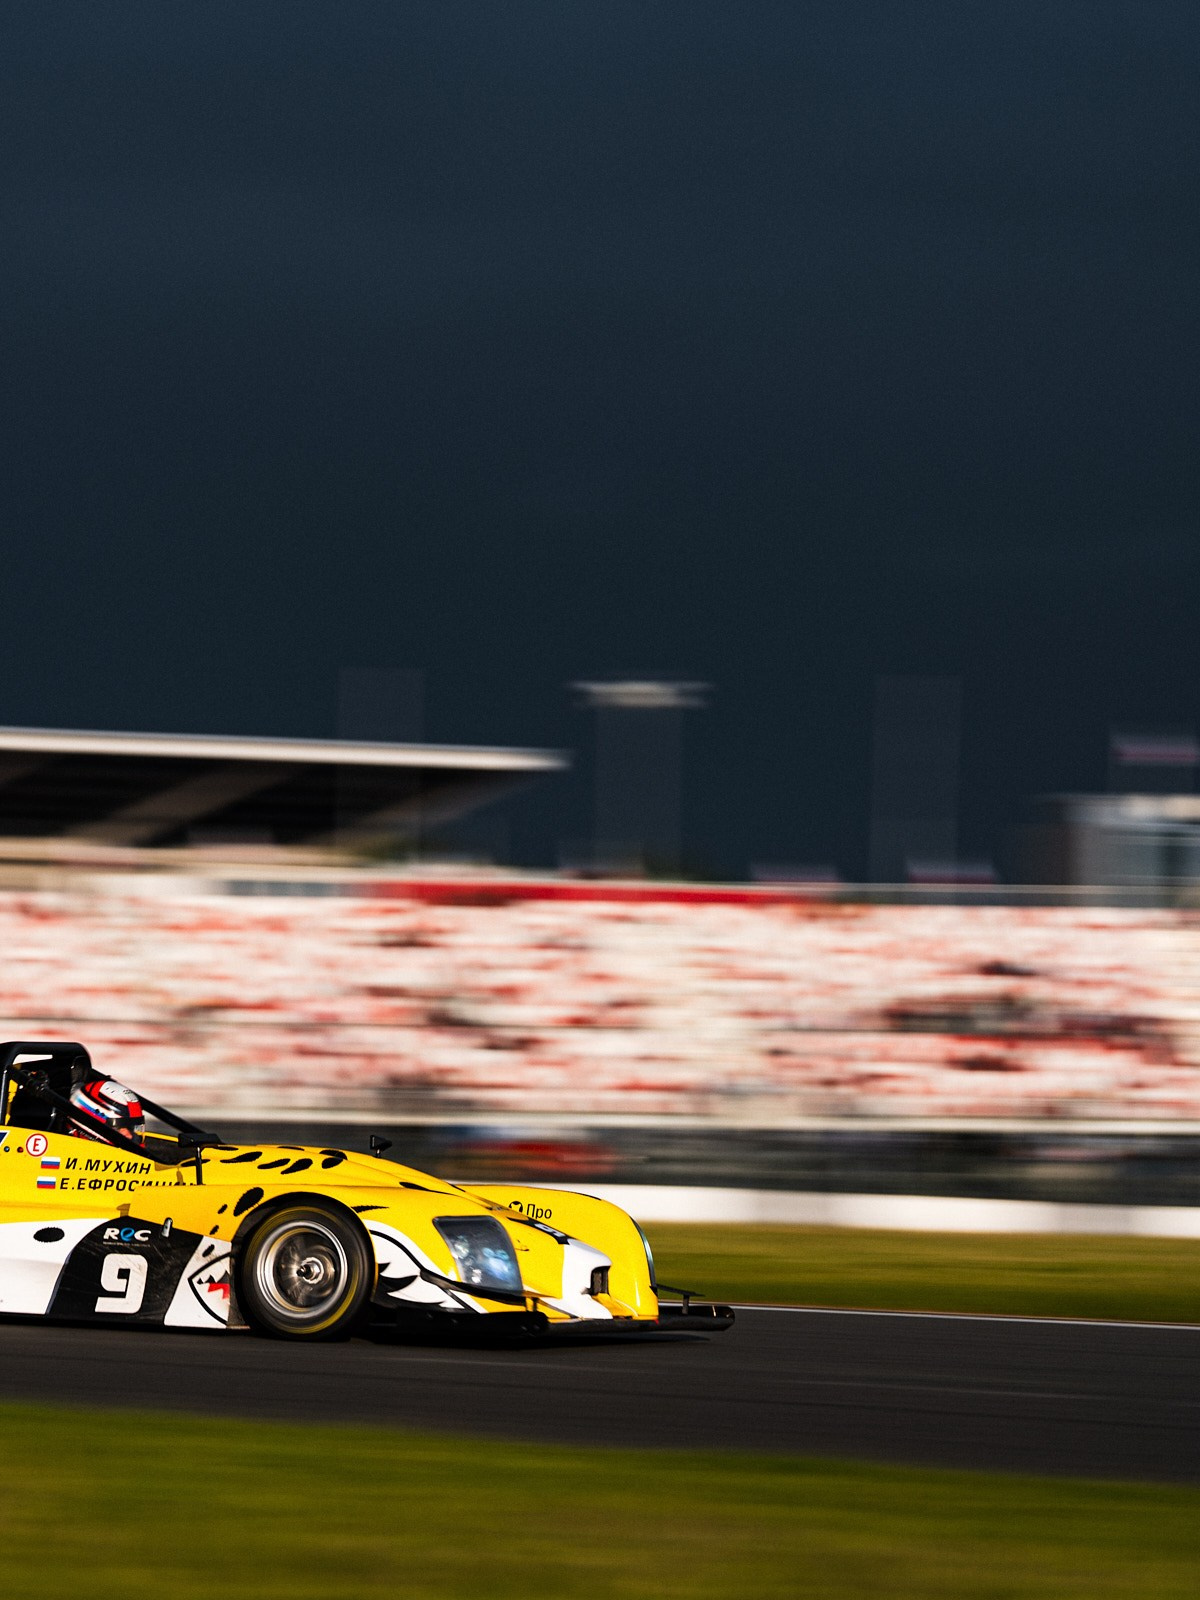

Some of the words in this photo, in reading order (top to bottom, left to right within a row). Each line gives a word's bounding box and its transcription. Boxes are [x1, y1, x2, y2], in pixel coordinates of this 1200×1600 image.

[33, 1138, 41, 1152] E
[65, 1157, 151, 1175] И.МУХИН
[60, 1178, 193, 1192] Е.ЕФРОС
[526, 1203, 552, 1219] Про
[94, 1253, 148, 1314] 9
